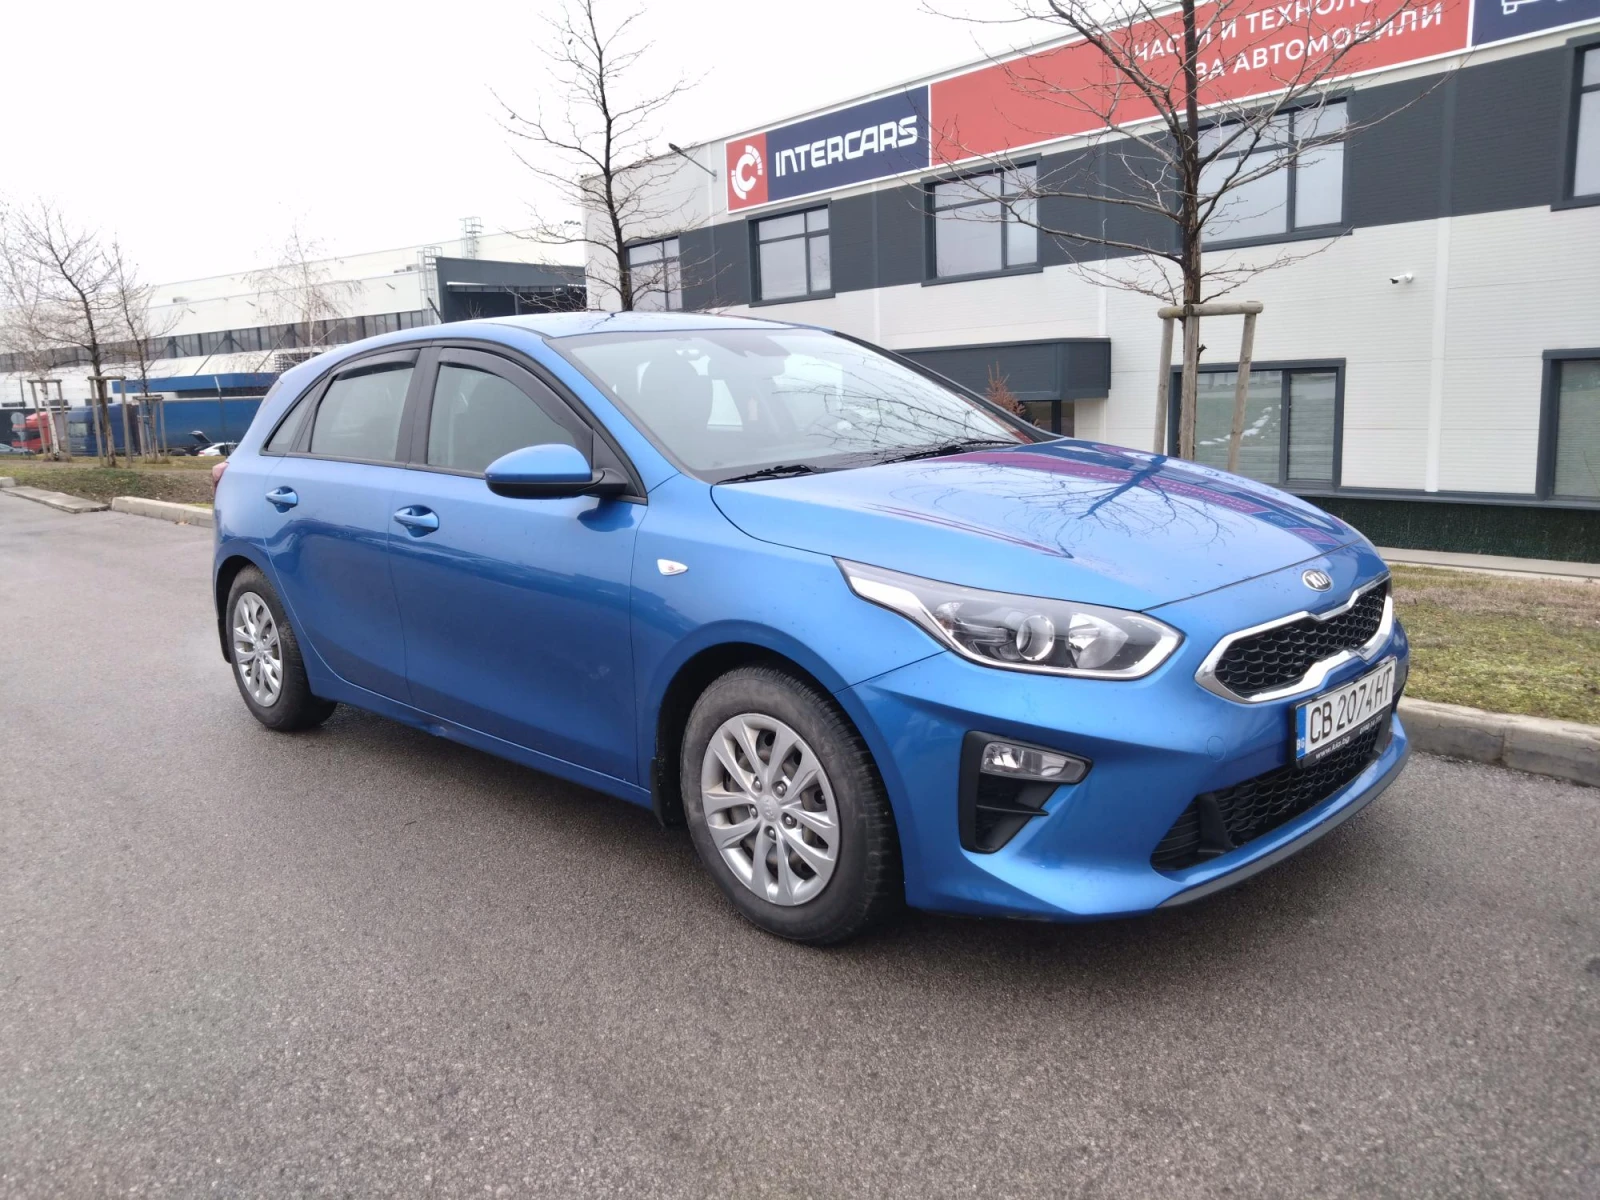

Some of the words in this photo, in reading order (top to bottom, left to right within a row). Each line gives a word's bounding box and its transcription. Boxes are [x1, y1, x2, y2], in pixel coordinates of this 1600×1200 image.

[1134, 27, 1211, 62] ЧАСИ
[1221, 19, 1237, 41] И
[1195, 58, 1226, 82] ЗА
[1233, 2, 1443, 74] АВТОМОБИЛИ
[775, 114, 918, 178] INTERCARS
